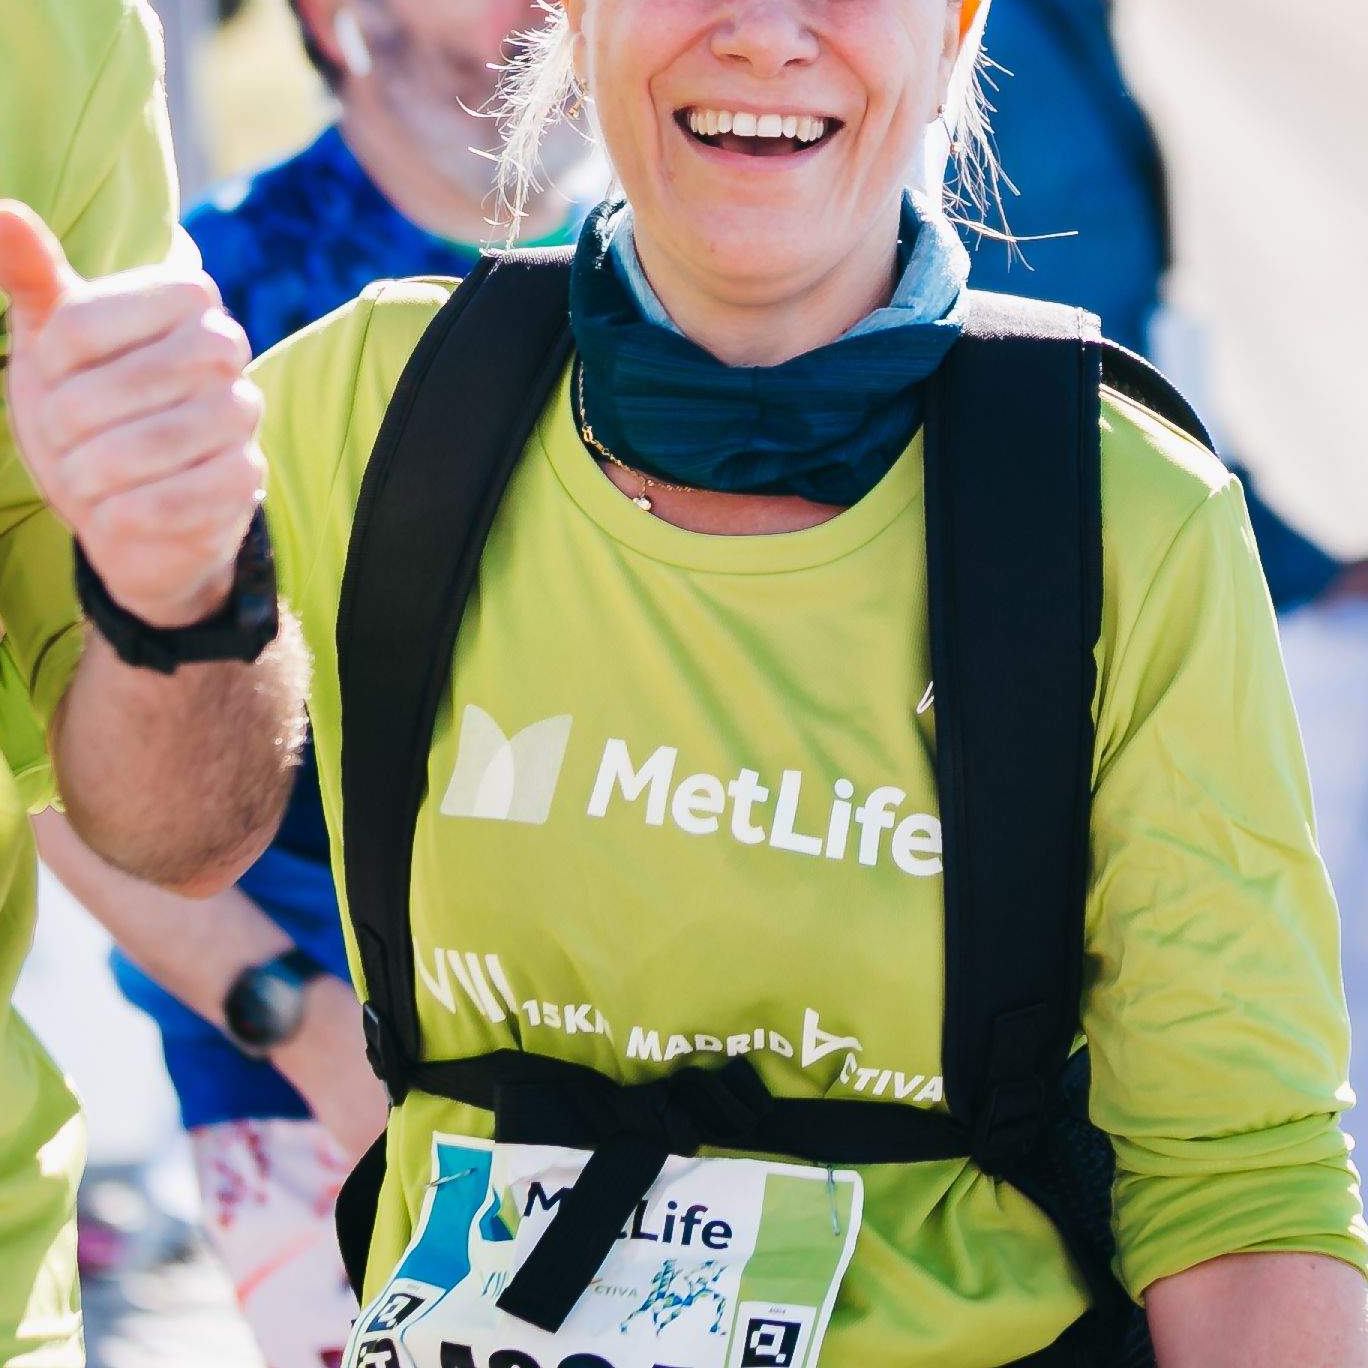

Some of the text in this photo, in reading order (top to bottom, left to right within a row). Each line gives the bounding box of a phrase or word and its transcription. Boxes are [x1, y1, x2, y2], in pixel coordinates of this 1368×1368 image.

[586, 737, 944, 877] MetLife
[414, 944, 519, 1023] VIII
[626, 1025, 795, 1062] MADRID
[524, 1181, 733, 1250] MLife
